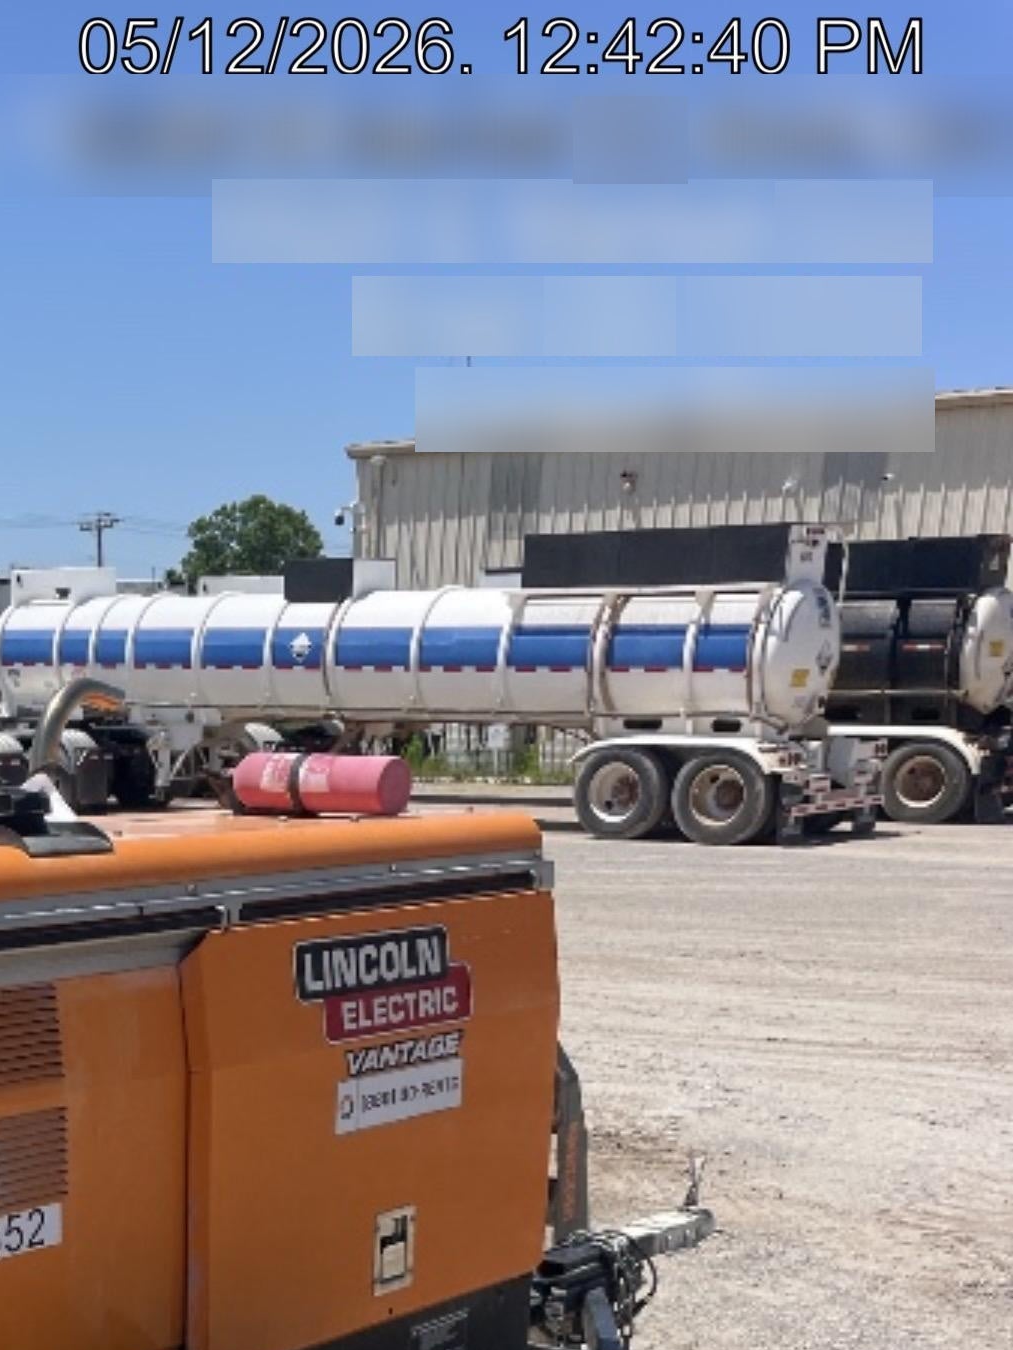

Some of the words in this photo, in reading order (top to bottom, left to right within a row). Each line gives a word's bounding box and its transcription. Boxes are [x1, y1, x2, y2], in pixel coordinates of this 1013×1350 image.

[303, 936, 443, 992] LINCOLN
[342, 986, 459, 1030] ELECTRIC
[346, 1032, 462, 1075] VANTAGE
